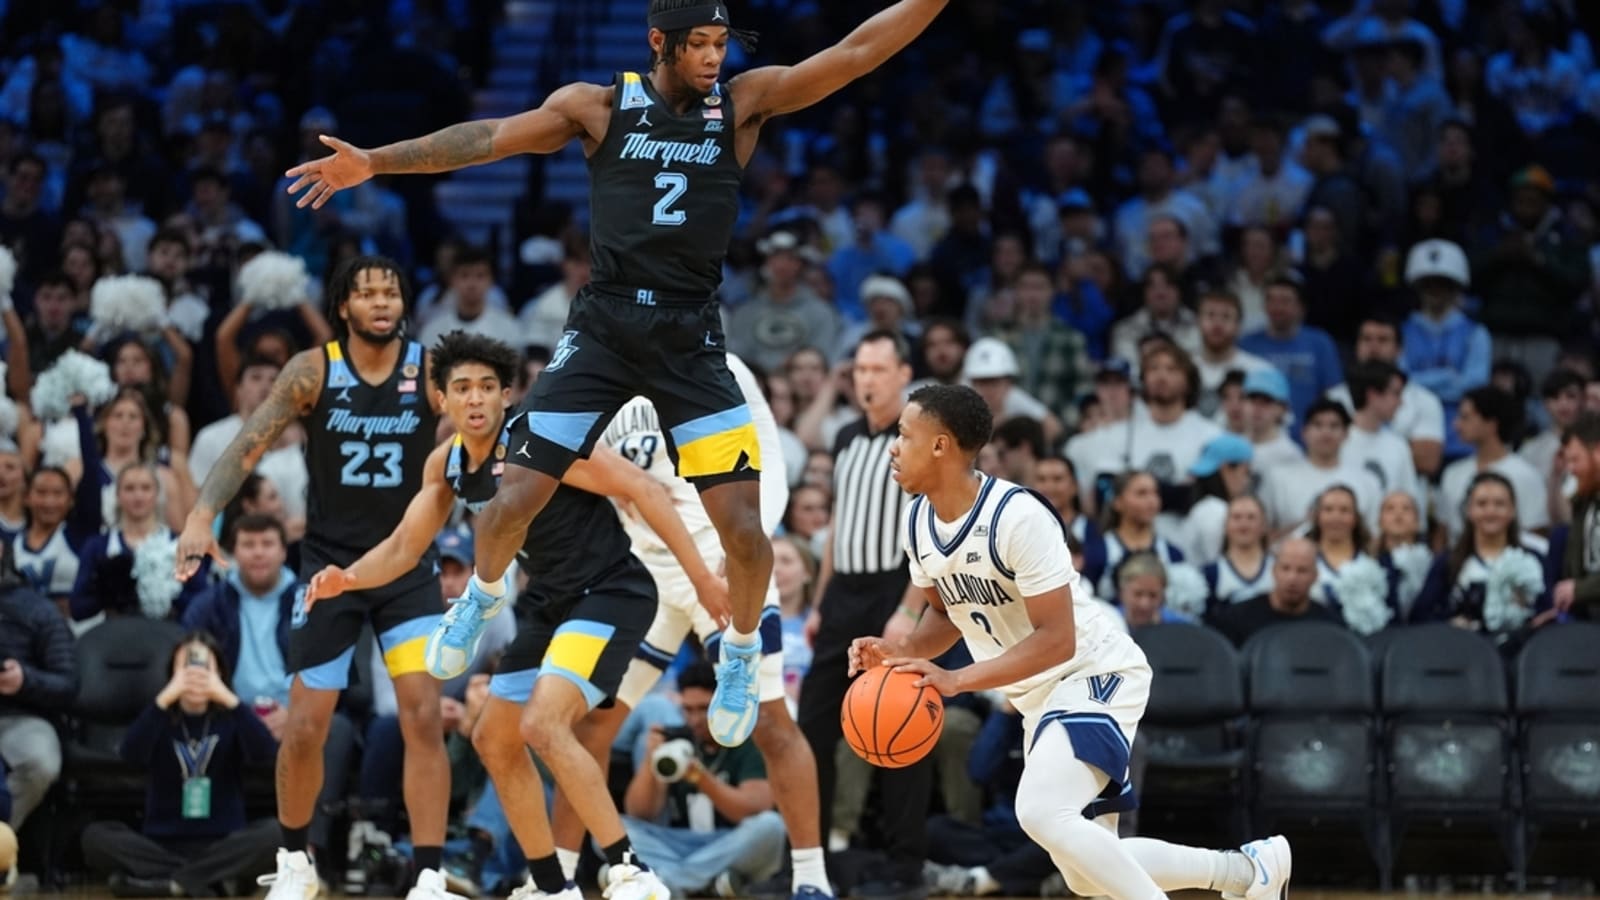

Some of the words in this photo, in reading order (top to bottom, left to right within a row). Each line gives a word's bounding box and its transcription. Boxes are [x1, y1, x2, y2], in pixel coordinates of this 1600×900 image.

[620, 133, 721, 168] Marquette
[652, 172, 688, 225] 2
[326, 408, 421, 440] Marquette
[340, 441, 403, 487] 23
[1086, 671, 1124, 705] V
